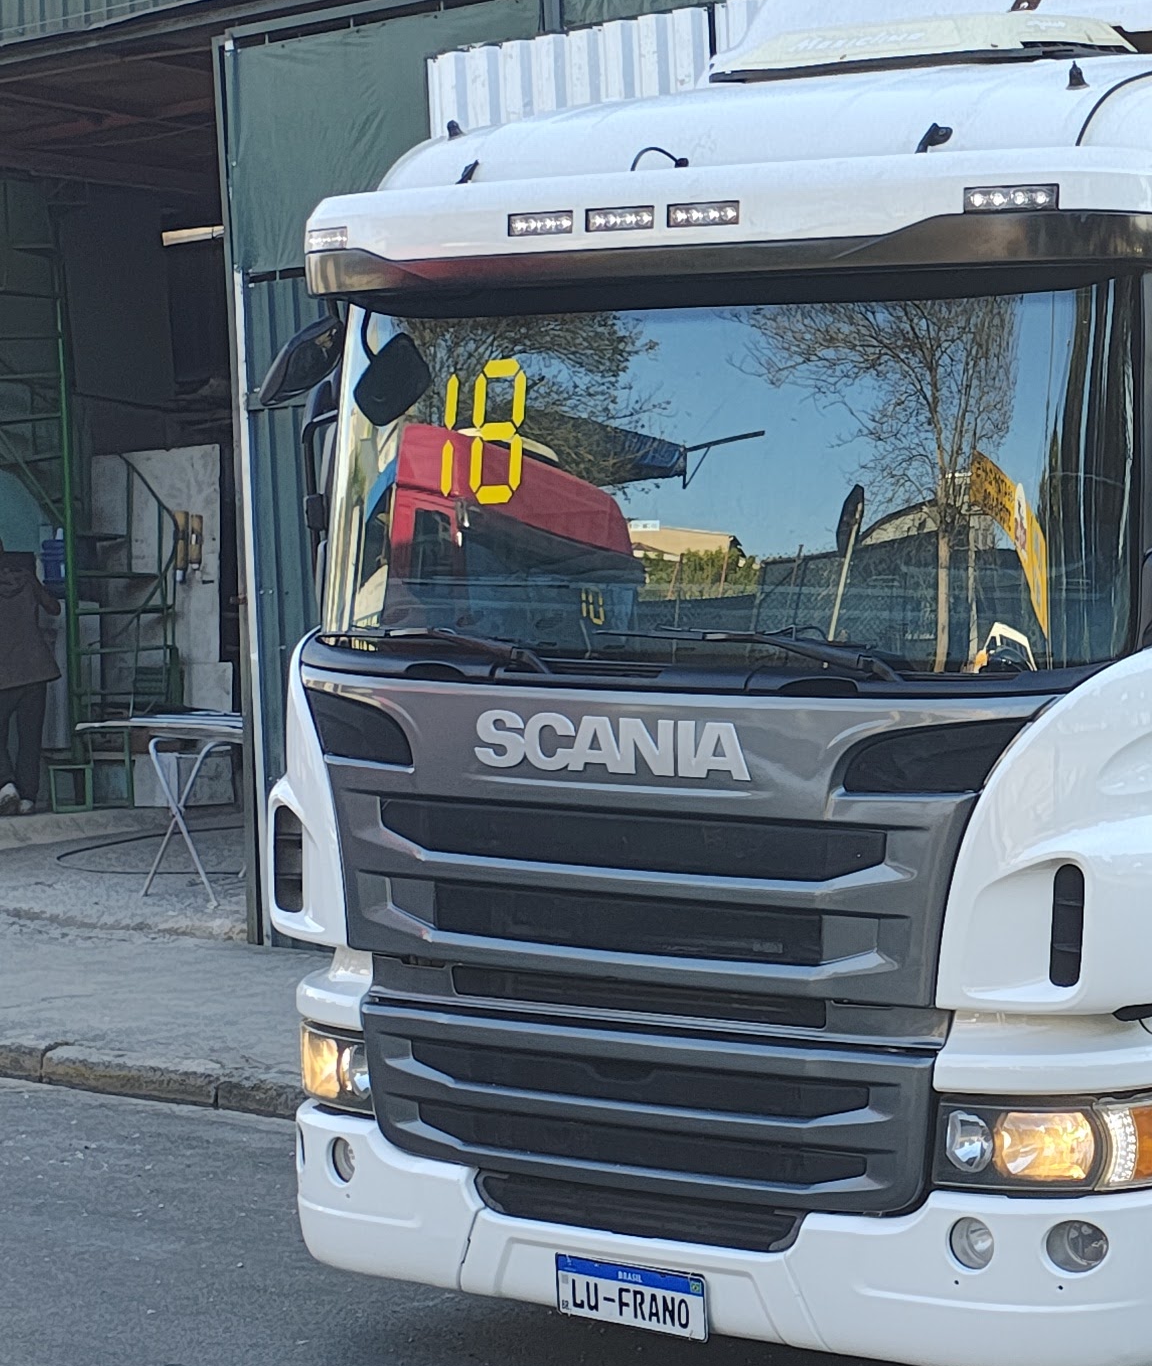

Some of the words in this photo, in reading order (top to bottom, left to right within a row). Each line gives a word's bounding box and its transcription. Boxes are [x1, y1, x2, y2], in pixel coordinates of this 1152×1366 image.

[440, 358, 527, 504] 18
[474, 708, 752, 782] SCANIA
[571, 1278, 690, 1329] LU-FRANO
[617, 1270, 643, 1283] BRASIL
